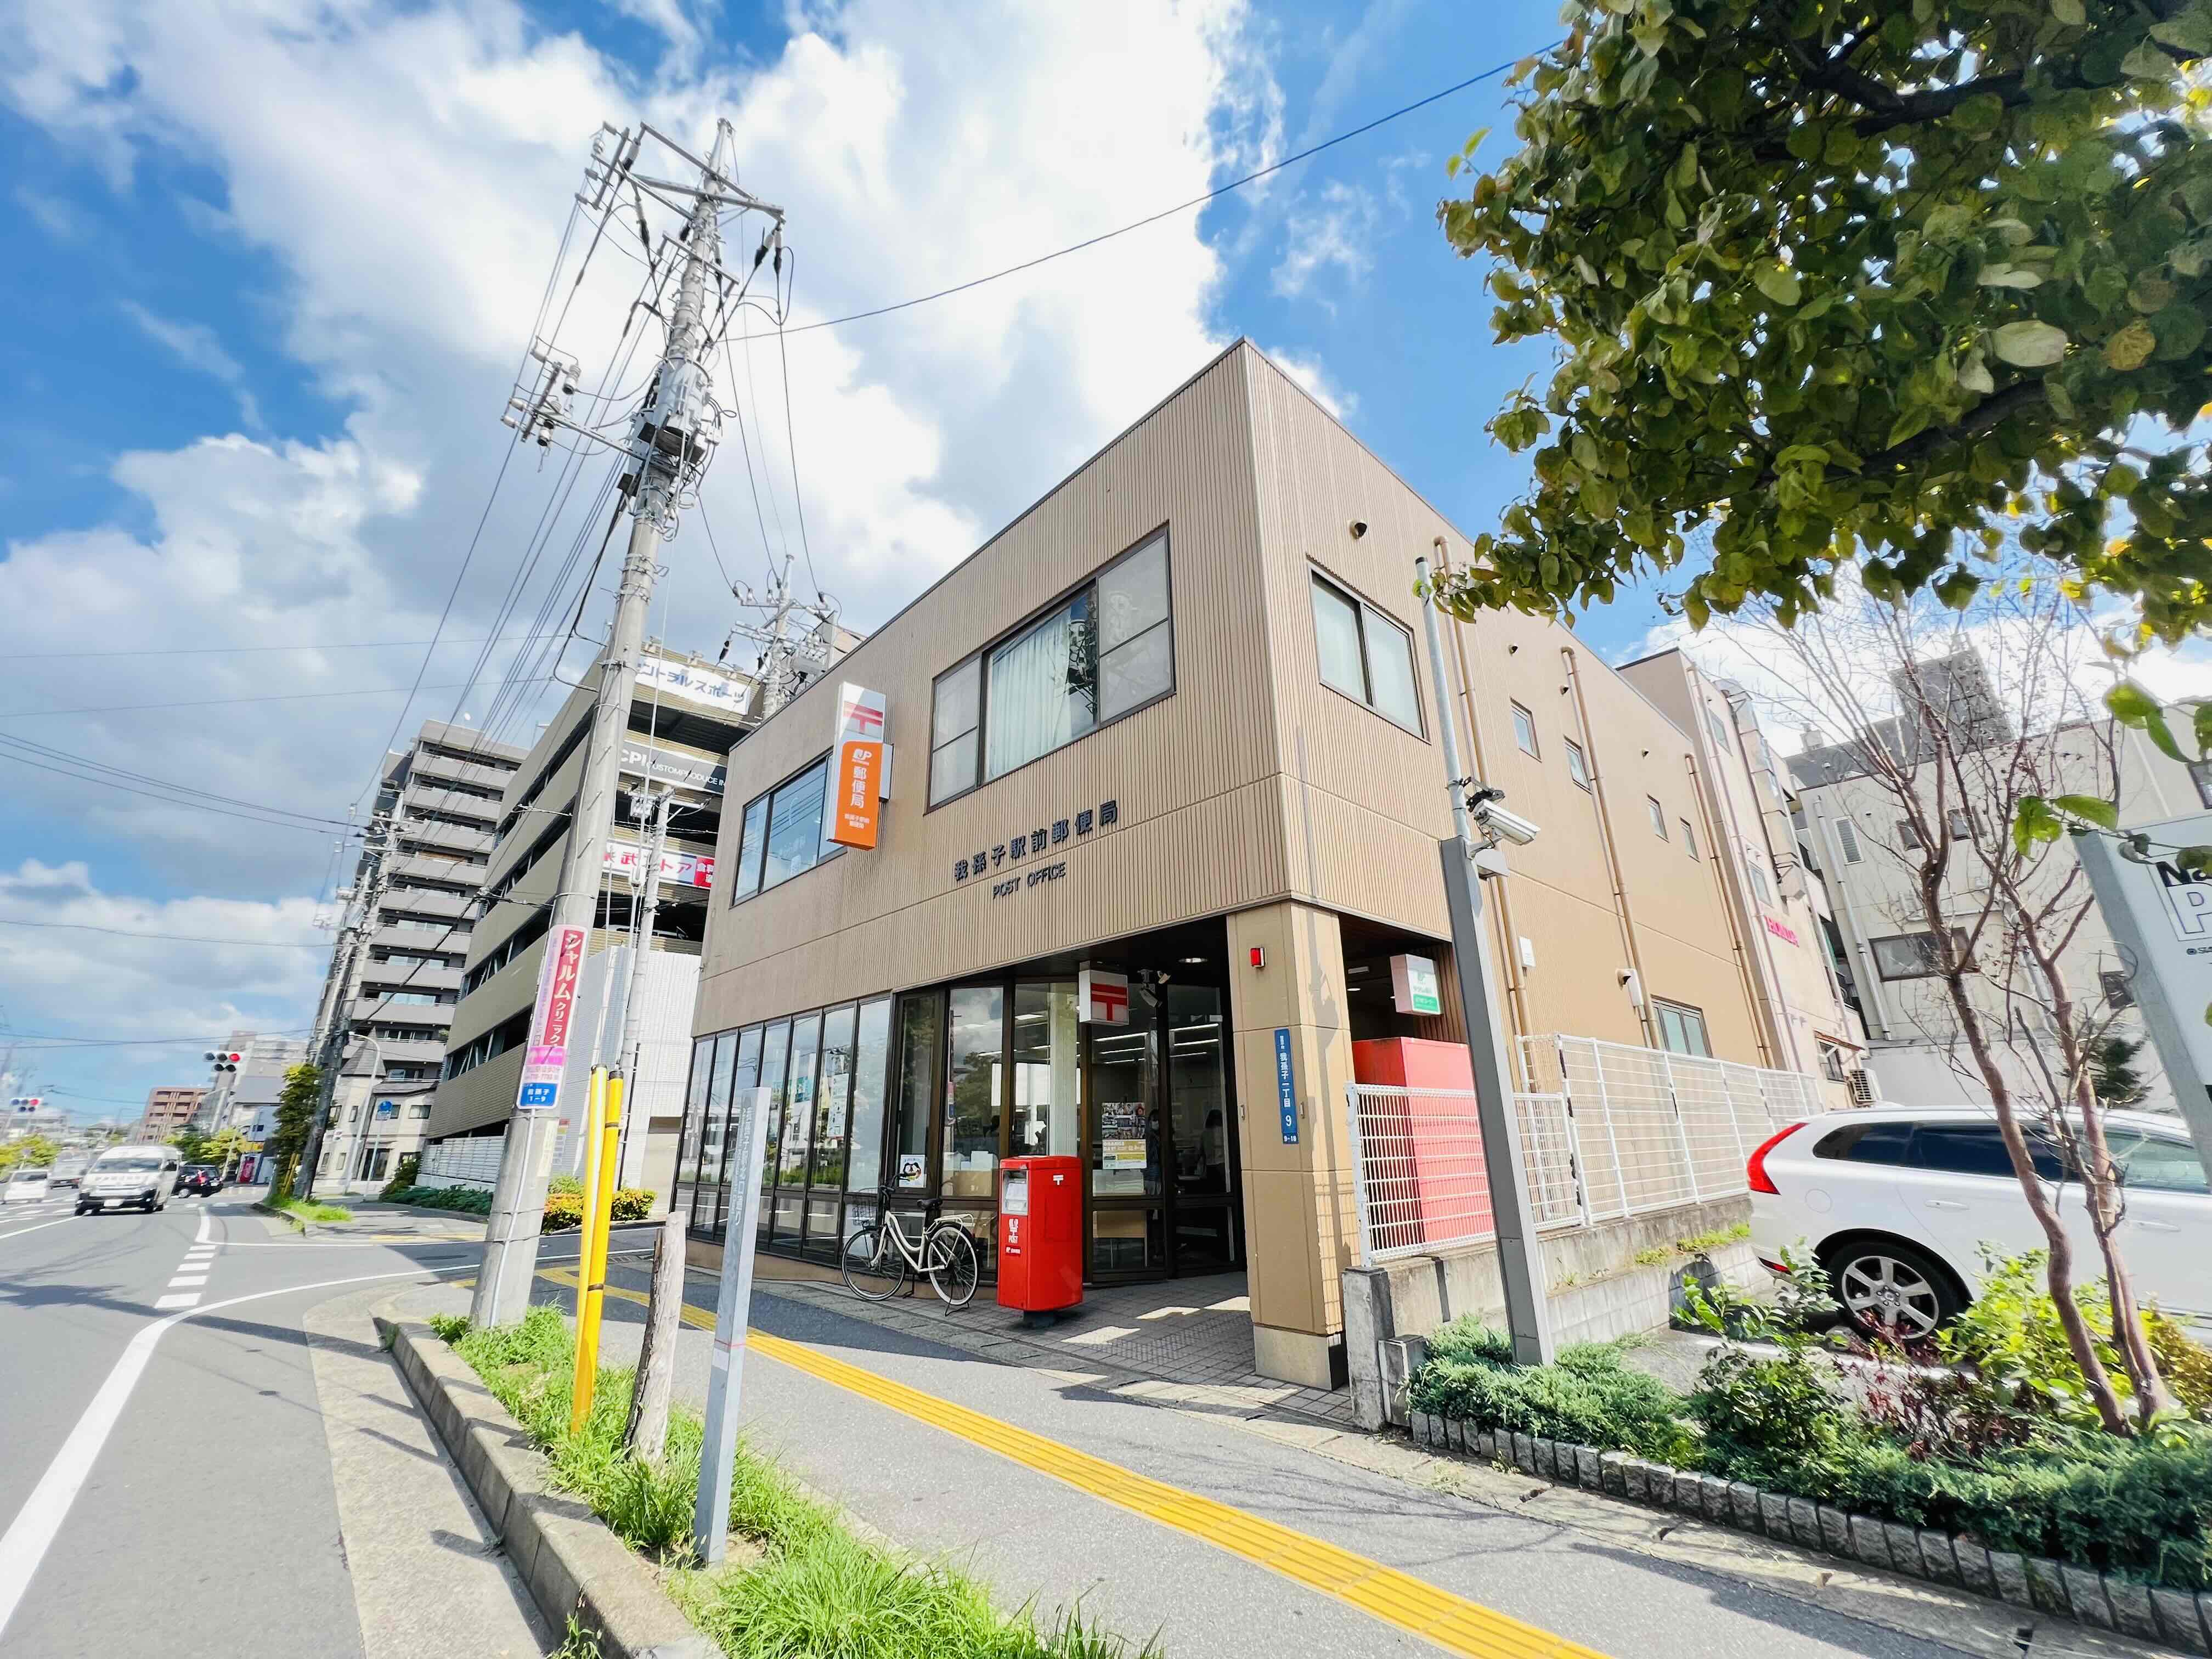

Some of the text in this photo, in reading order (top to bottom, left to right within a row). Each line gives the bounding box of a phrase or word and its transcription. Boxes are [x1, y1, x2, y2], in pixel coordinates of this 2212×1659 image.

[850, 766, 867, 808] 郵便局
[955, 800, 1118, 881] 我孫子駅前郵便局
[993, 862, 1066, 899] POST OFFICE
[1285, 1115, 1292, 1126] 9
